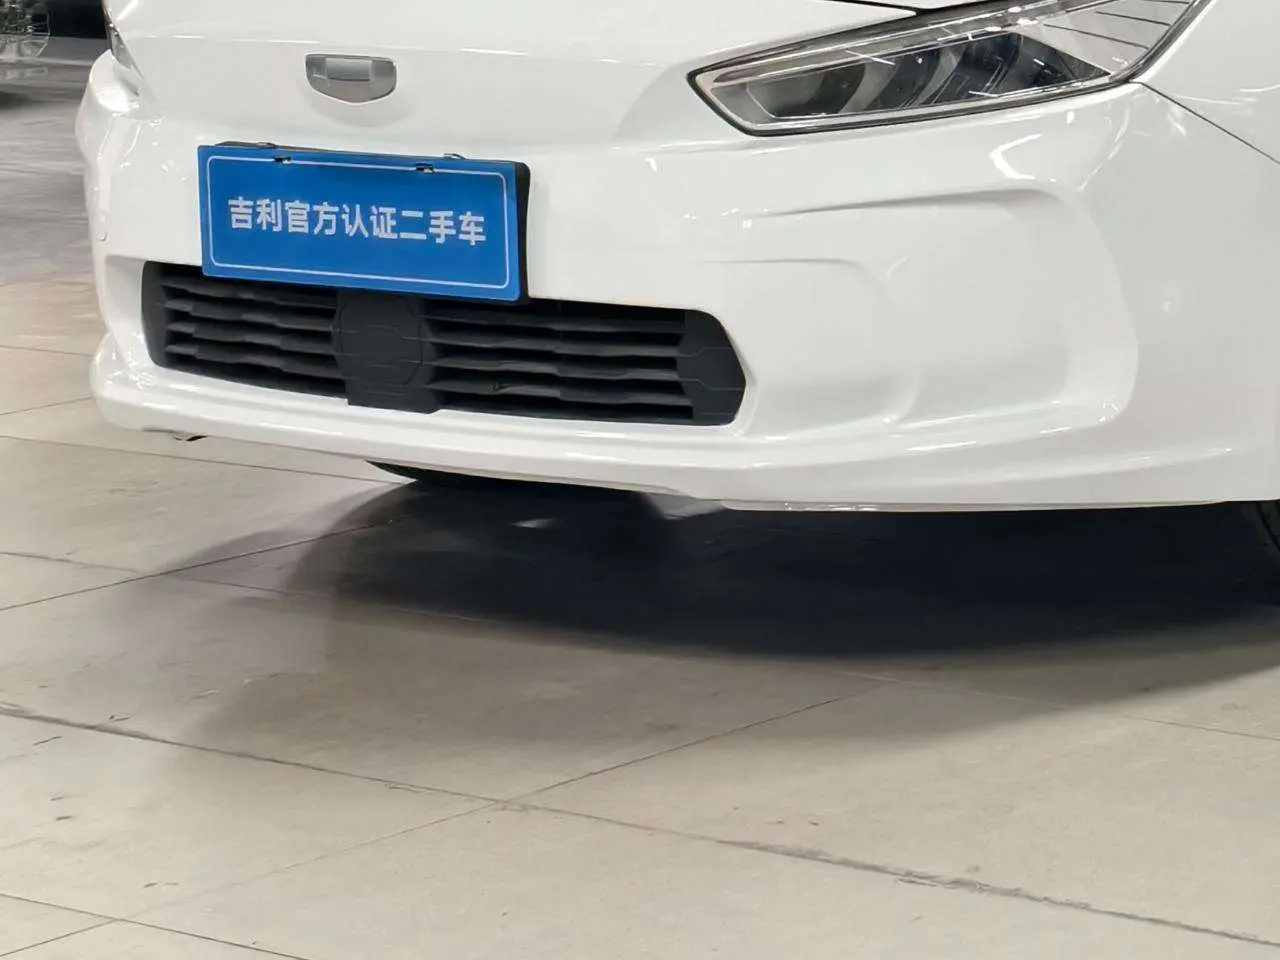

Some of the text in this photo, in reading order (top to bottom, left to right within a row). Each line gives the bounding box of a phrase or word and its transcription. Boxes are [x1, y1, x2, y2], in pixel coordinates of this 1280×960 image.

[227, 196, 487, 246] 吉利官方认证二手车
